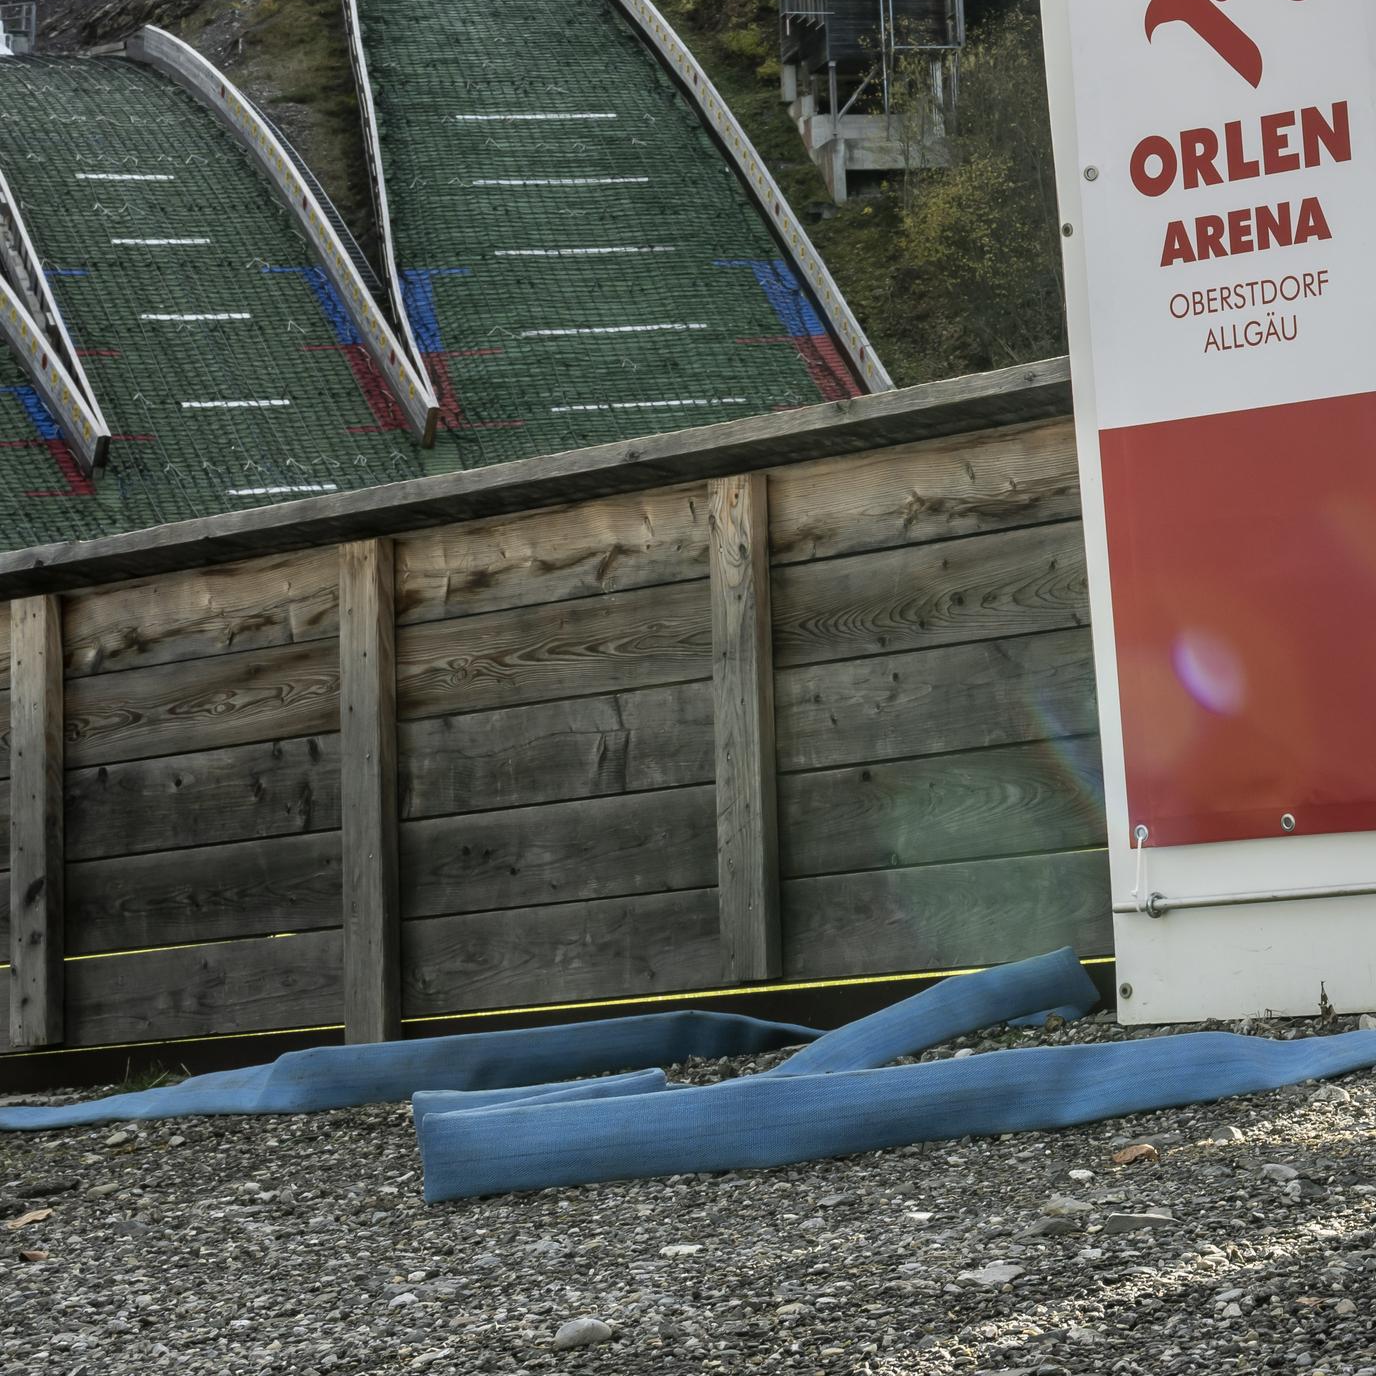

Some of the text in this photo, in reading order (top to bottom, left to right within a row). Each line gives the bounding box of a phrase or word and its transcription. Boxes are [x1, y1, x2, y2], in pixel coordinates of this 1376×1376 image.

[1130, 100, 1352, 197] ORLEN
[1160, 196, 1332, 267] ARENA
[1170, 270, 1329, 318] OBERSTDORF
[1204, 312, 1297, 353] ALLGÄU
